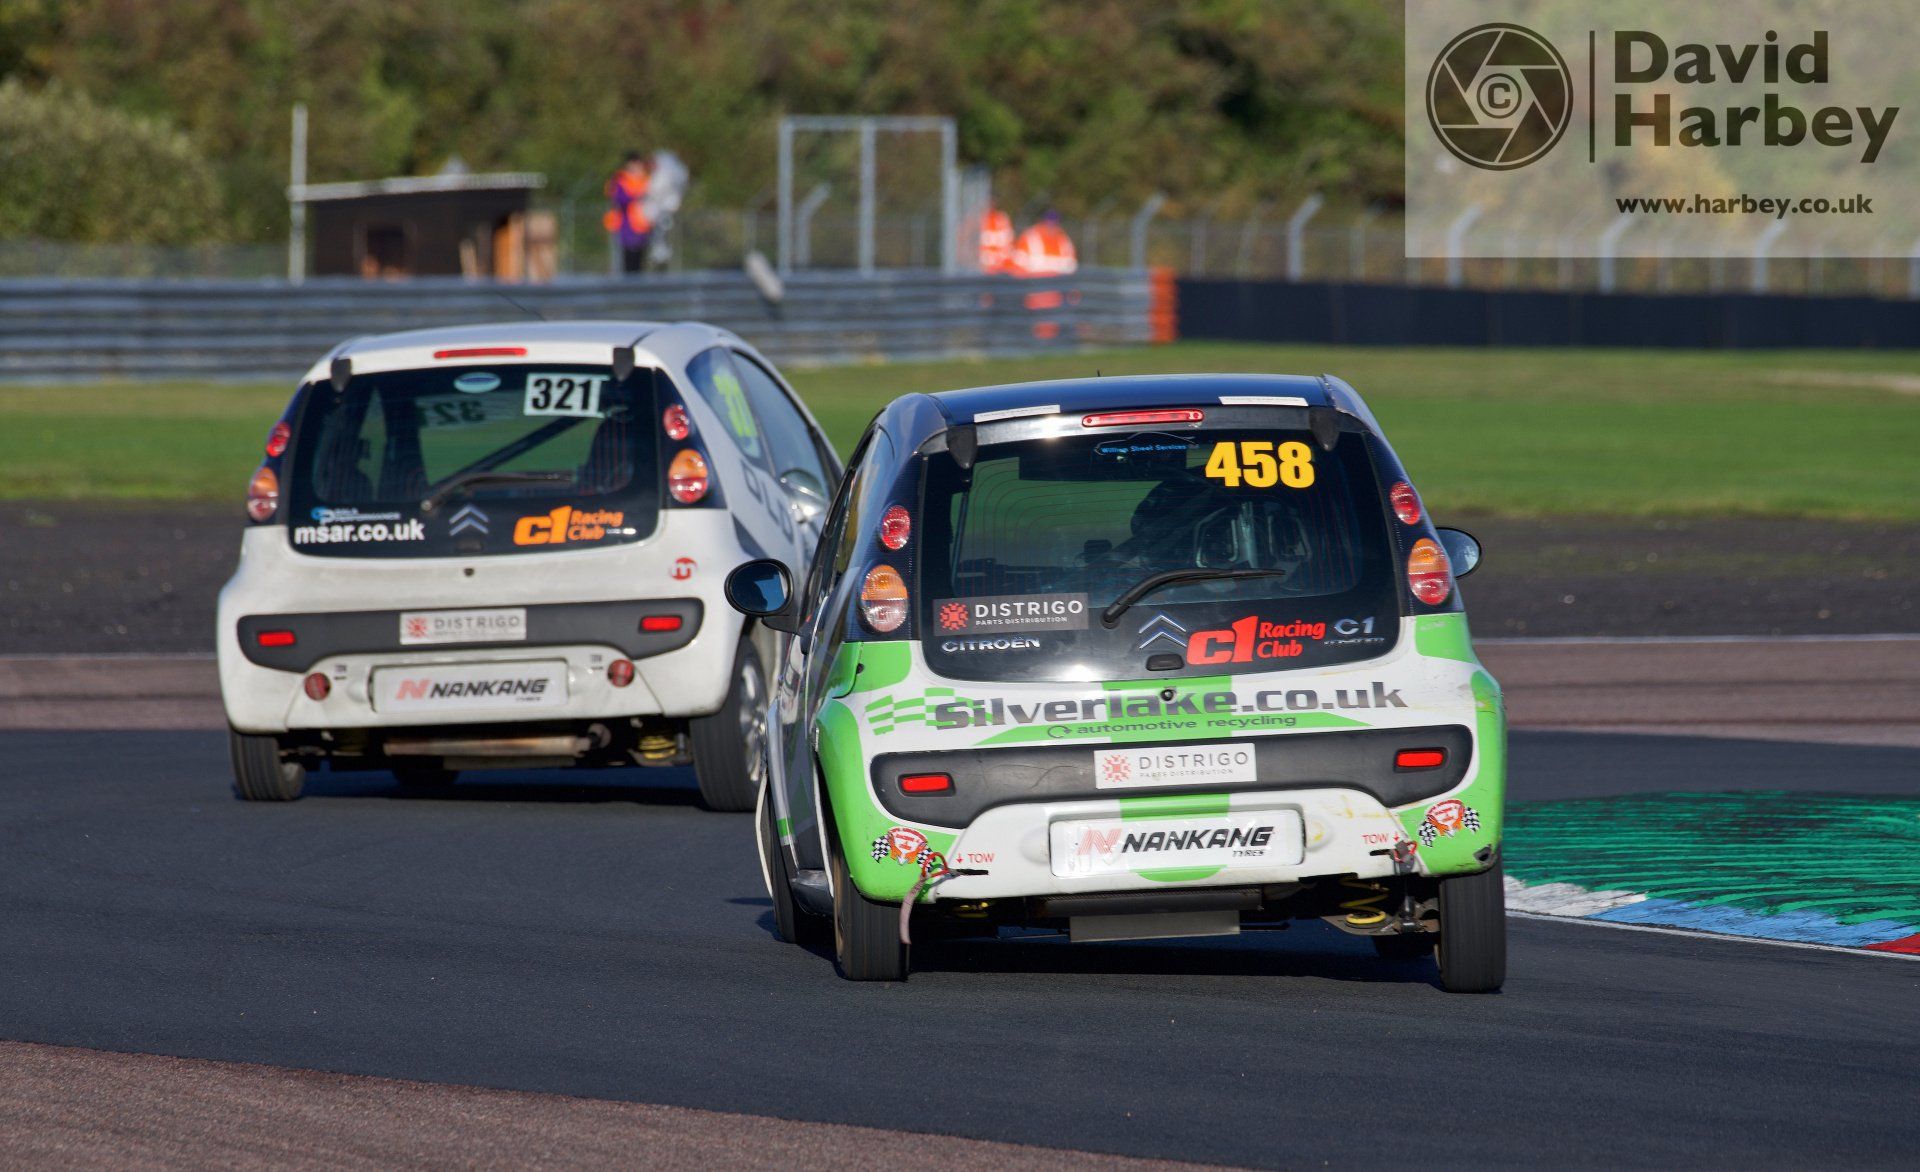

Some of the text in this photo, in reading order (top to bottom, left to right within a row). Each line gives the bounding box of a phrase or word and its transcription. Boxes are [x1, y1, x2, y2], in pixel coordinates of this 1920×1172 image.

[532, 378, 592, 411] 321
[1204, 441, 1315, 489] 458
[571, 509, 624, 527] Racing
[294, 518, 425, 544] msar.co.uk
[568, 524, 605, 541] Club
[975, 600, 1084, 618] DISTRIGO
[434, 615, 520, 630] DISTRIGO
[1005, 617, 1068, 625] DISTRIBUTION
[1259, 619, 1326, 639] Racing
[1333, 616, 1376, 635] C1
[941, 636, 1041, 652] CITROËN
[1257, 640, 1304, 659] Club
[430, 678, 549, 699] NANKANG
[935, 681, 1409, 731] Silverlake.co.uk
[1076, 715, 1297, 735] automotive recycling
[1139, 752, 1249, 770] DISTRIGO
[1121, 826, 1275, 853] NANKANG
[1362, 833, 1389, 844] TOW
[967, 853, 995, 863] TOW
